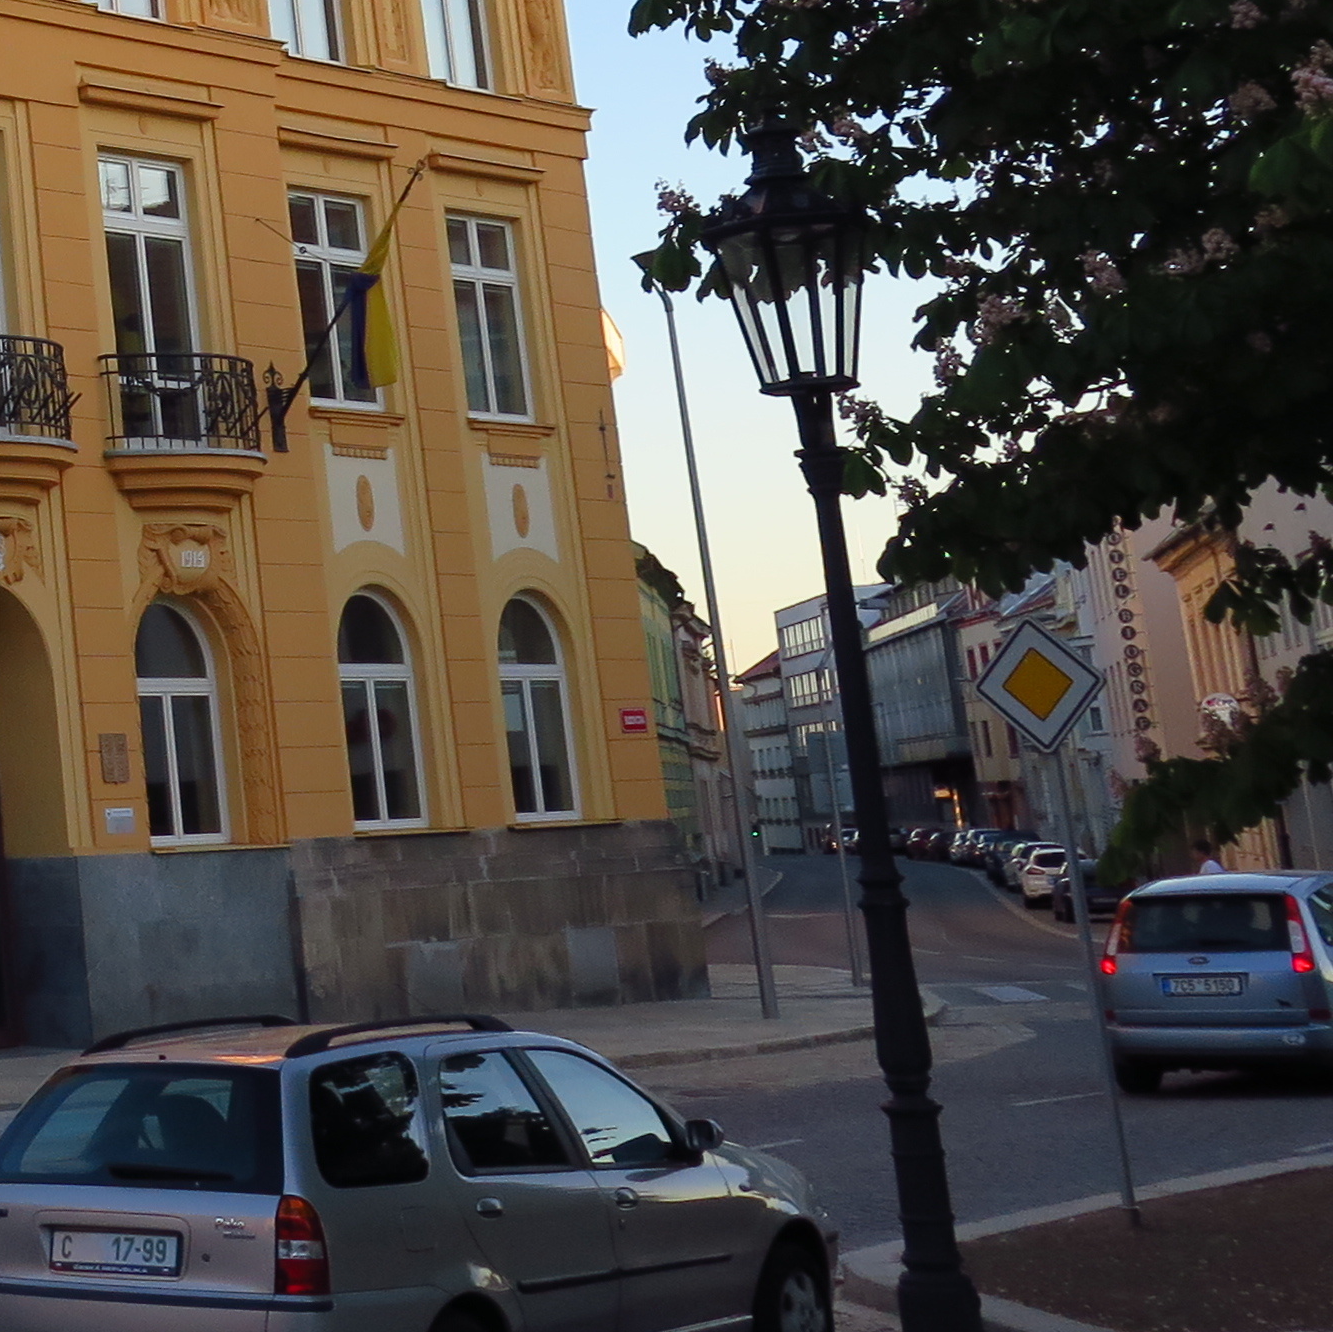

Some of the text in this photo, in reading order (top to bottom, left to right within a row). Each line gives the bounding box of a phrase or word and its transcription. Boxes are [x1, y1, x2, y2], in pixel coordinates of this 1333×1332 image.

[1118, 608, 1151, 731] BIOGRAF
[61, 1235, 167, 1264] C 17-99
